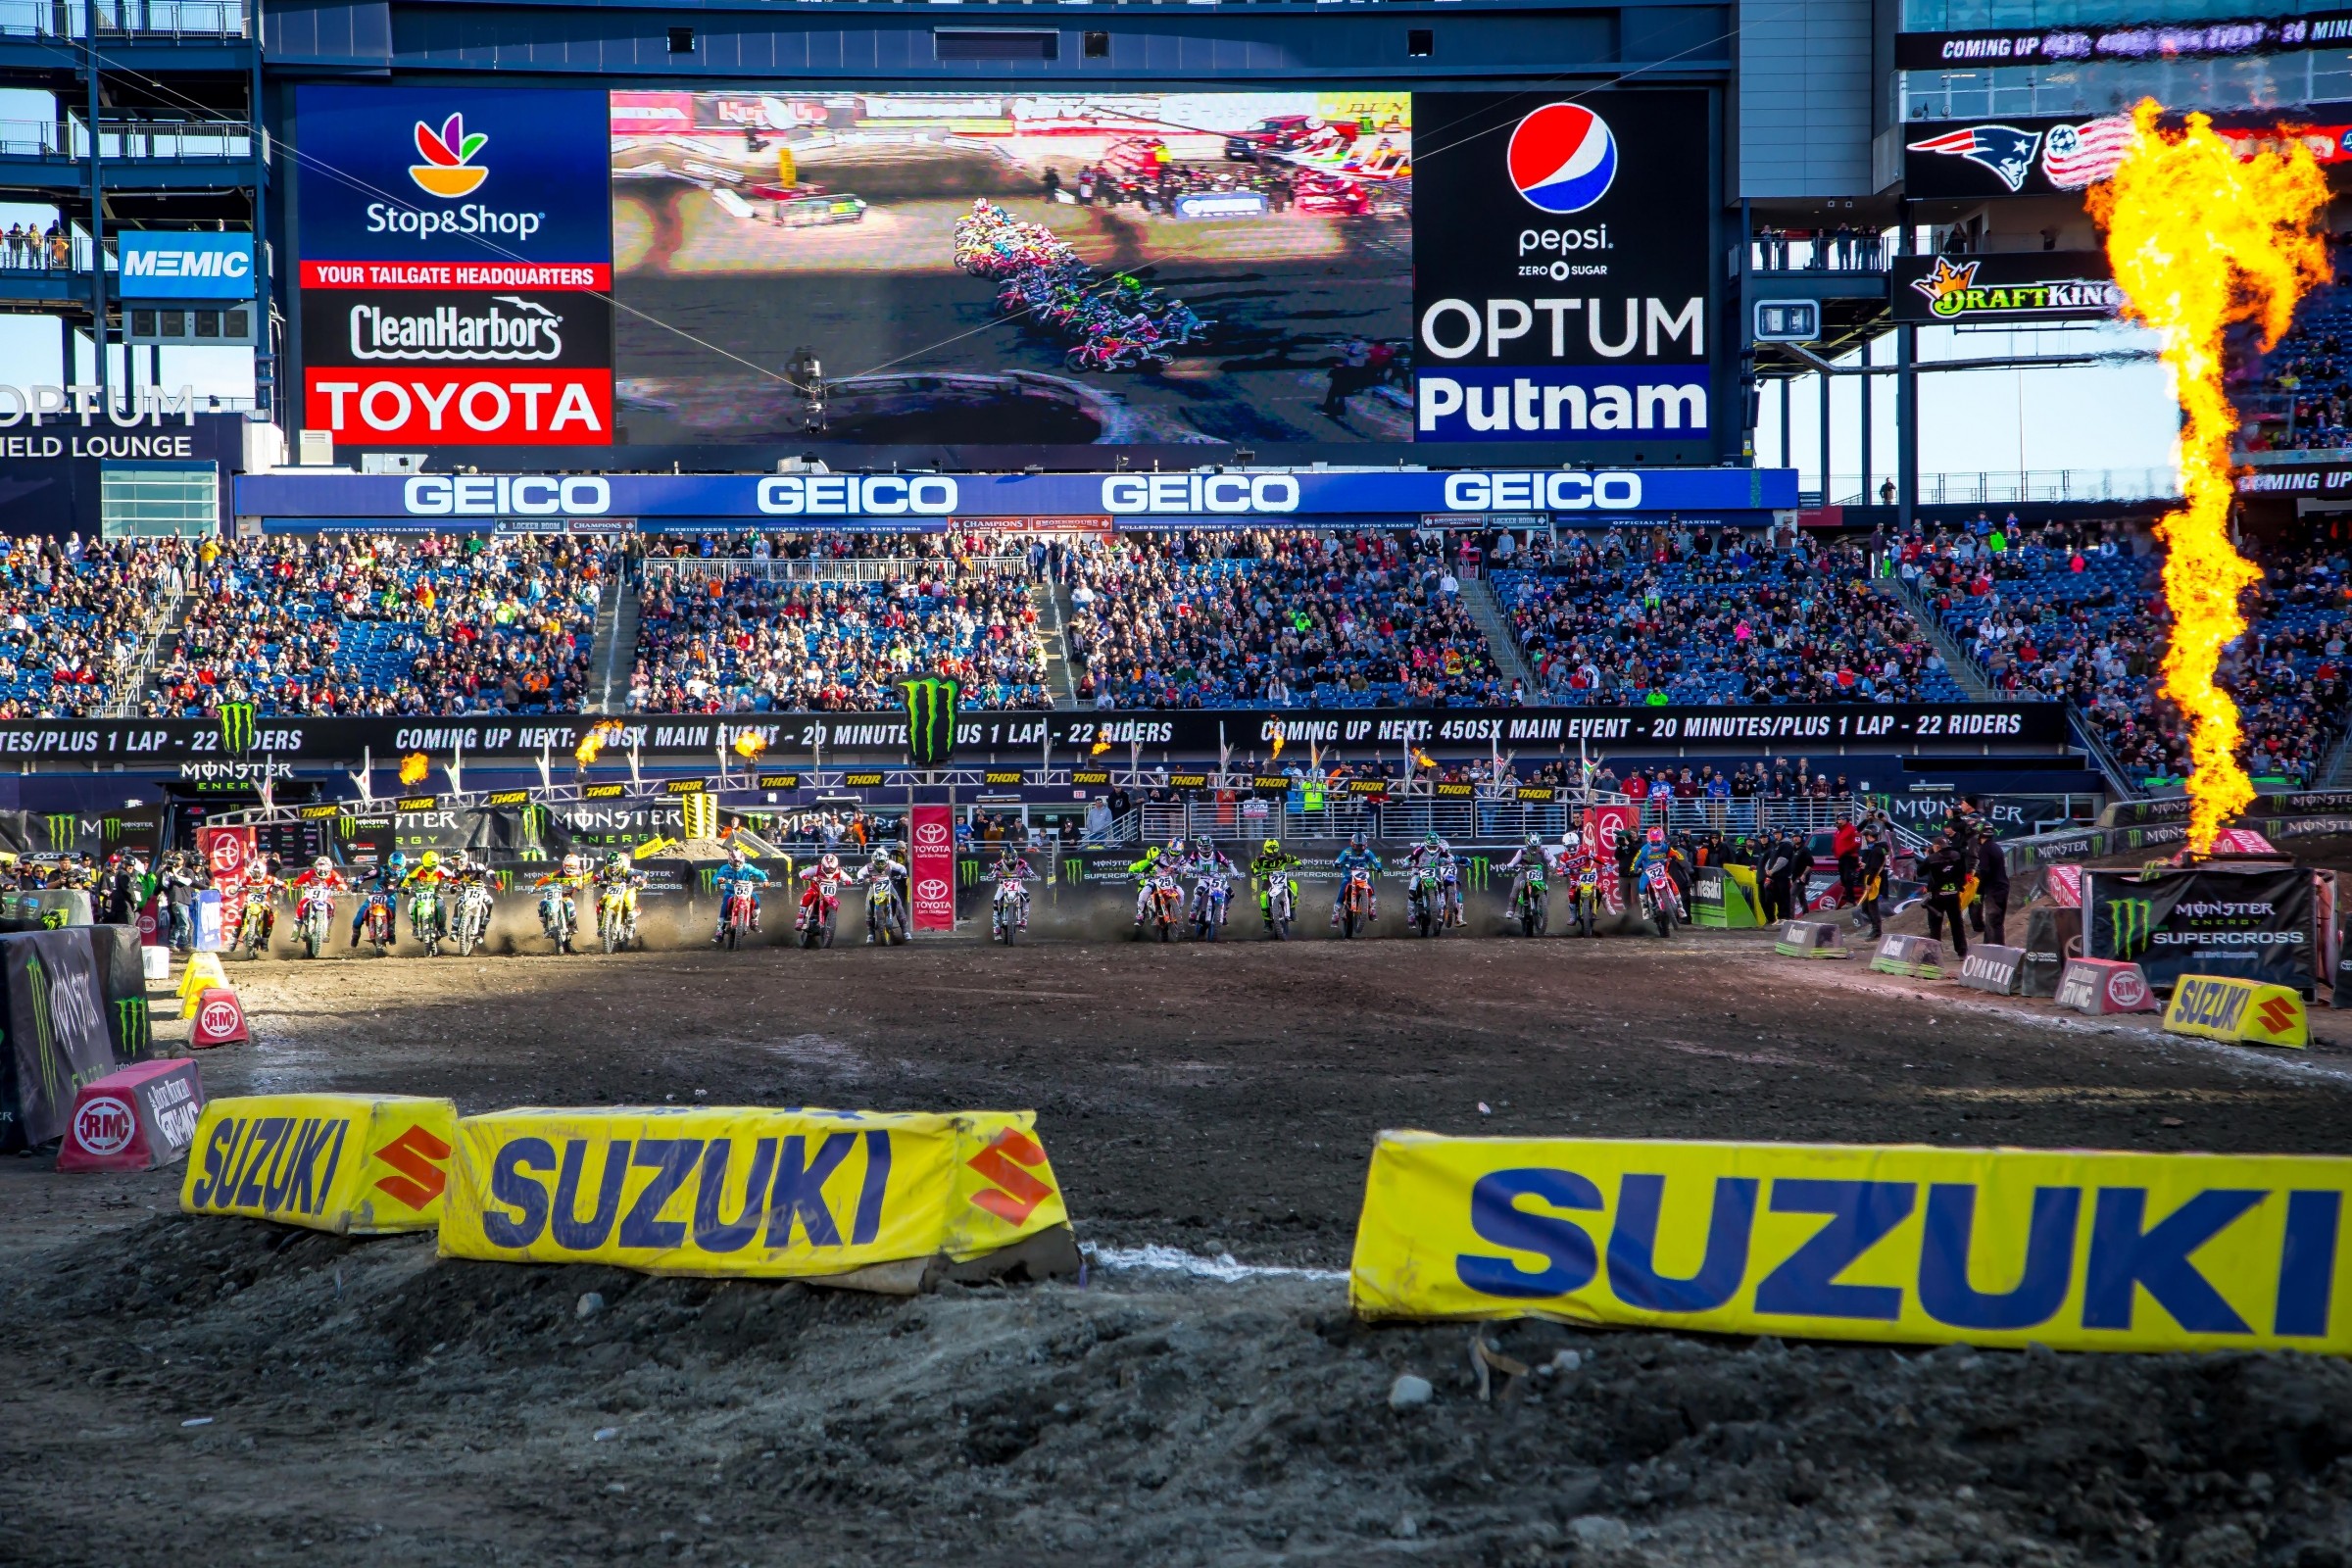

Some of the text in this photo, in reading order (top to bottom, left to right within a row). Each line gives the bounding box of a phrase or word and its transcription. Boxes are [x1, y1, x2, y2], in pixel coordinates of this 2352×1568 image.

[1942, 38, 2012, 59] COMING
[2015, 36, 2040, 57] UP
[367, 203, 540, 240] Stop&Shop
[1519, 223, 1607, 257] pepsi
[124, 250, 251, 278] MEMIC
[1518, 265, 1608, 276] ZERO SUGAR
[317, 266, 594, 286] YOUR TAILGATE HEADQUARTERS
[350, 304, 563, 361] CleanHarbors
[1421, 297, 1704, 359] OPTUM
[316, 380, 602, 432] TOYOTA
[1419, 376, 1707, 432] Putnam
[72, 436, 192, 458] LOUNGE
[2325, 471, 2352, 488] UP
[405, 476, 612, 515] GEICO
[757, 475, 957, 514] GEICO
[1102, 474, 1299, 513] GEICO
[1445, 472, 1642, 510] GEICO
[512, 521, 561, 530] LOCKER ROOM
[963, 519, 1024, 528] CHAMPIONS
[395, 721, 1174, 750] COMING UP NEXT: MAIN EVT 20 MINUTEUS 1 LAP 22 RIDERS
[1260, 713, 2023, 742] COMING UP NEXT: 450SX MAIN EVENT 20 MINUTES/PLUS 1 LAP 22 RIDERS
[108, 731, 119, 752] 1
[126, 730, 168, 752] LAP
[191, 729, 219, 752] 22
[250, 729, 303, 752] DERS
[180, 760, 295, 781] MONSTER
[986, 773, 1021, 783] THOR
[1072, 772, 1108, 783] THOR
[198, 782, 278, 791] ENERY
[667, 780, 703, 792] THOR
[760, 775, 797, 787] THOR
[846, 774, 882, 785] THOR
[1170, 775, 1204, 786] THOR
[1254, 777, 1290, 788] THOR
[1349, 781, 1385, 792] THOR
[586, 785, 622, 797] THOR
[1438, 784, 1472, 795] THOR
[1518, 789, 1552, 799] THOR
[398, 799, 435, 810] THOR
[491, 792, 526, 804] THOR
[301, 806, 338, 818] THOR
[1895, 797, 2025, 824] MONER
[2151, 800, 2193, 814] MONS
[395, 810, 459, 830] STER
[552, 808, 684, 831] MONSTER
[688, 793, 697, 838] THOR
[395, 836, 438, 845] RGY
[2146, 827, 2187, 843] MONS
[732, 839, 761, 858] THOR
[2037, 840, 2089, 858] MONSTER
[1271, 874, 1286, 885] 22
[1528, 871, 1543, 880] 69
[1580, 874, 1596, 883] 48
[1649, 868, 1662, 879] 32
[875, 883, 890, 892] 27
[1158, 877, 1171, 888] 25
[1941, 883, 1956, 892] 43
[250, 894, 266, 903] 39
[736, 886, 750, 896] 55
[823, 886, 835, 896] 10
[2175, 900, 2277, 917] MONSTER
[2153, 931, 2304, 944] SUPERCROSS
[2114, 980, 2141, 997] RM
[2175, 980, 2253, 1032] SUZUKI
[85, 1113, 123, 1139] RM
[192, 1117, 350, 1216] SUZUKI
[481, 1129, 892, 1253] SUZUKI
[1454, 1166, 2341, 1338] SUZUKI
